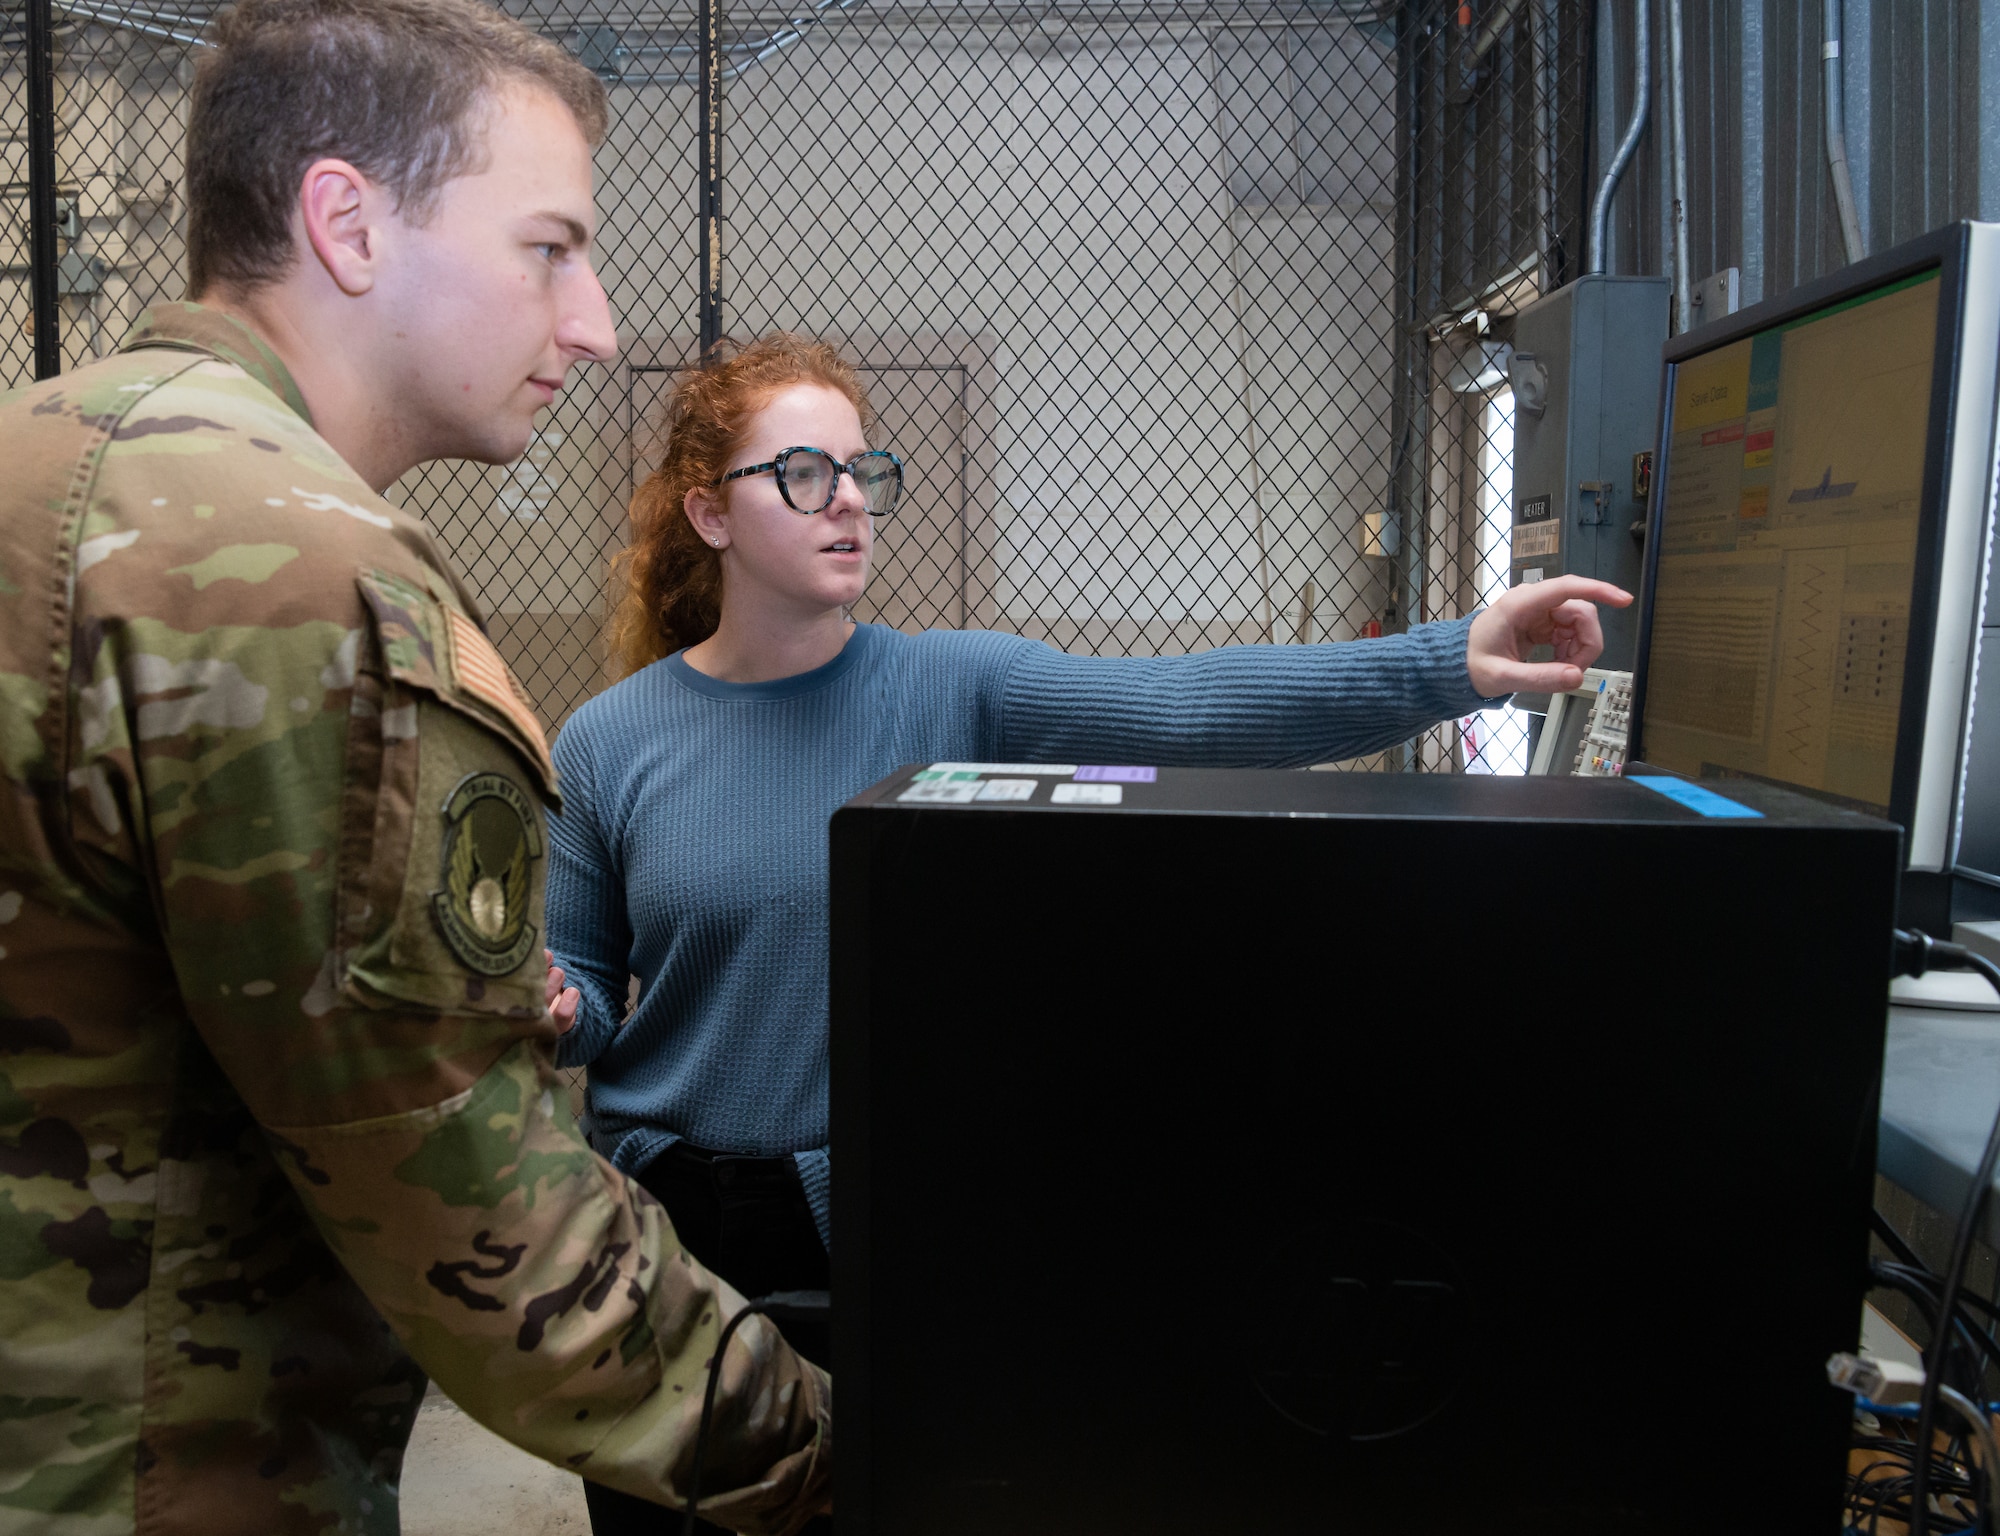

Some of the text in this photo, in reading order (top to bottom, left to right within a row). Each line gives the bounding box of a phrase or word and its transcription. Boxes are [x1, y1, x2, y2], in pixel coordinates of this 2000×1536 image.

[1690, 386, 1728, 408] Save Data
[1524, 501, 1546, 518] HEATER
